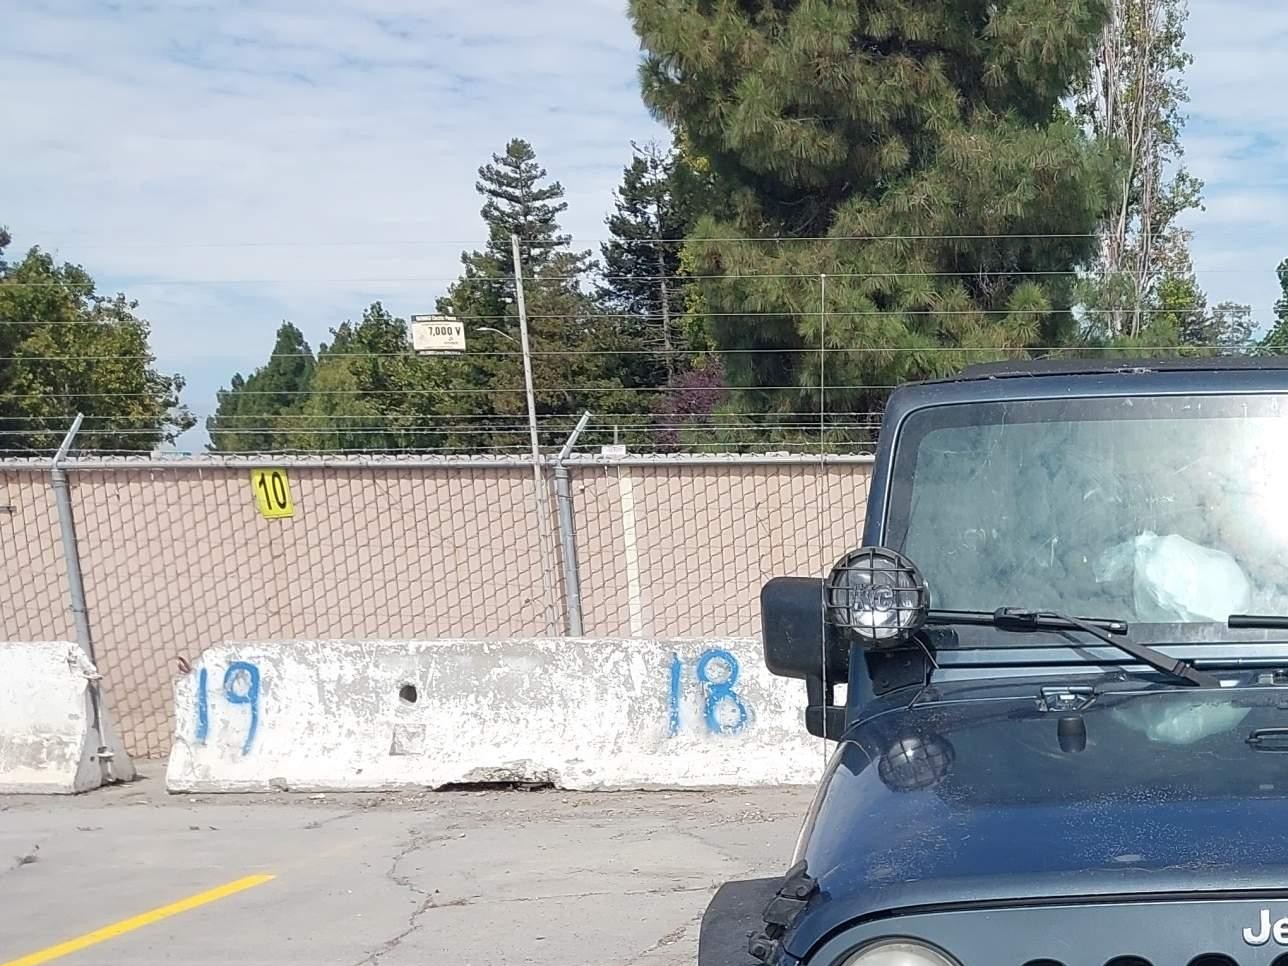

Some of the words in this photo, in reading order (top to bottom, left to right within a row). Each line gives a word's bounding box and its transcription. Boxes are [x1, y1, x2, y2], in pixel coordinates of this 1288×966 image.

[454, 326, 461, 336] V
[258, 471, 287, 510] 10
[196, 660, 260, 756] 19
[669, 649, 747, 736] 18
